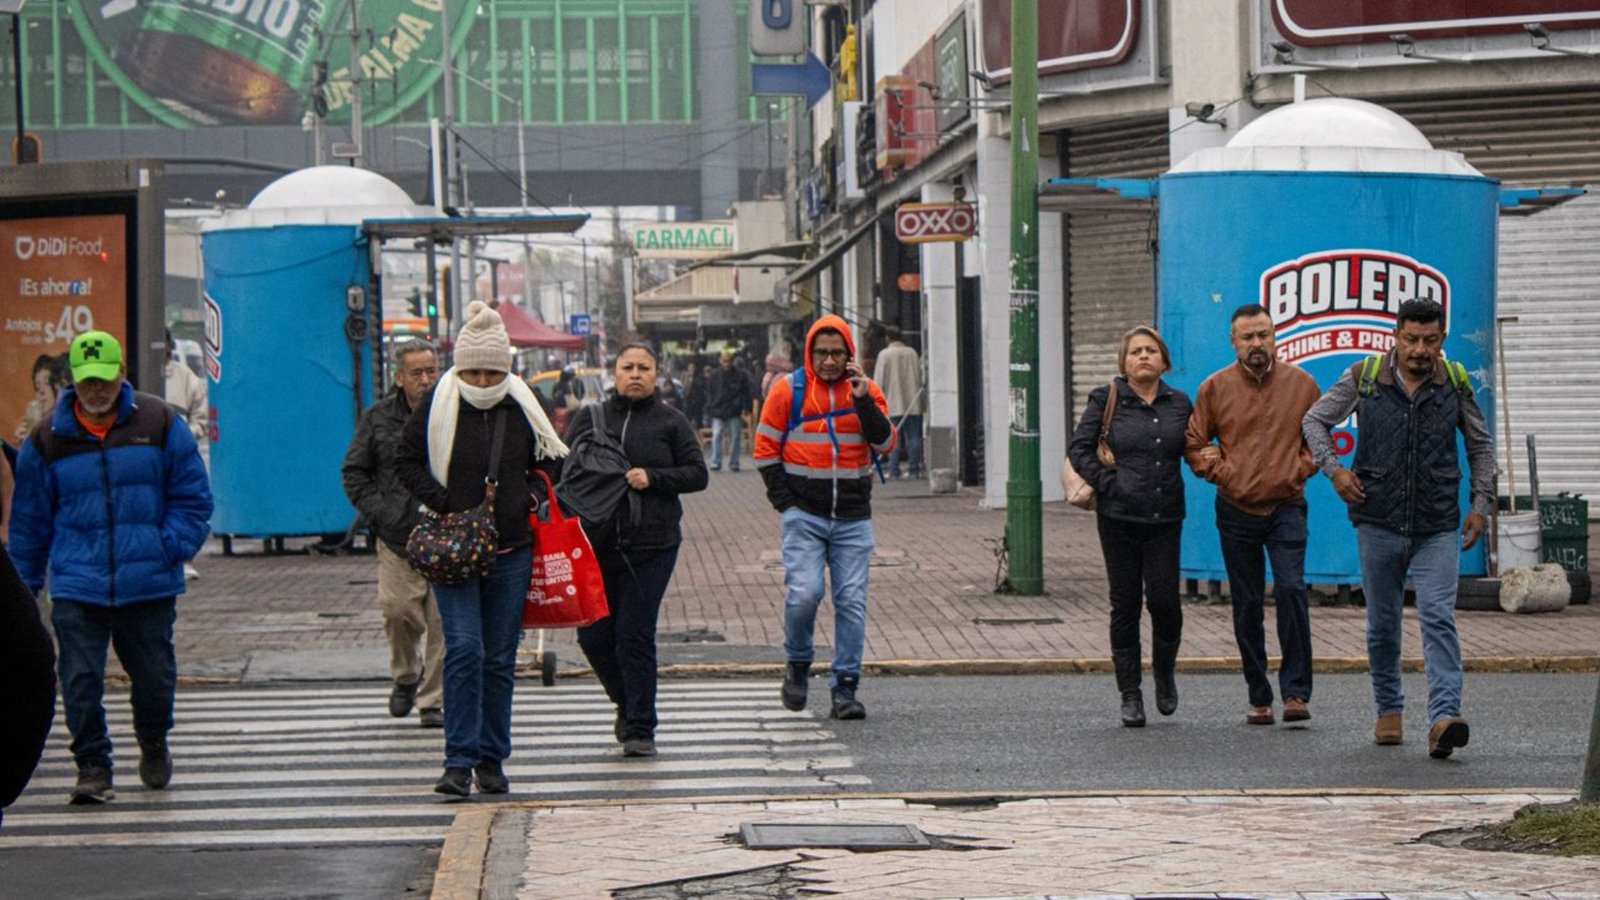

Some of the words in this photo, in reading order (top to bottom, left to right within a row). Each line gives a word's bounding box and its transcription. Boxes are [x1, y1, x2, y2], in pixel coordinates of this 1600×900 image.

[194, 0, 301, 38] DIO
[360, 12, 433, 79] ALMA
[636, 224, 734, 249] FARMACI
[900, 208, 971, 236] OXXO
[37, 236, 67, 256] DiDi
[68, 233, 102, 256] Food
[41, 277, 92, 296] ahorra!
[43, 305, 94, 345] $49
[1276, 331, 1332, 361] SHINE
[1336, 331, 1354, 347] &
[1358, 331, 1397, 351] PRO
